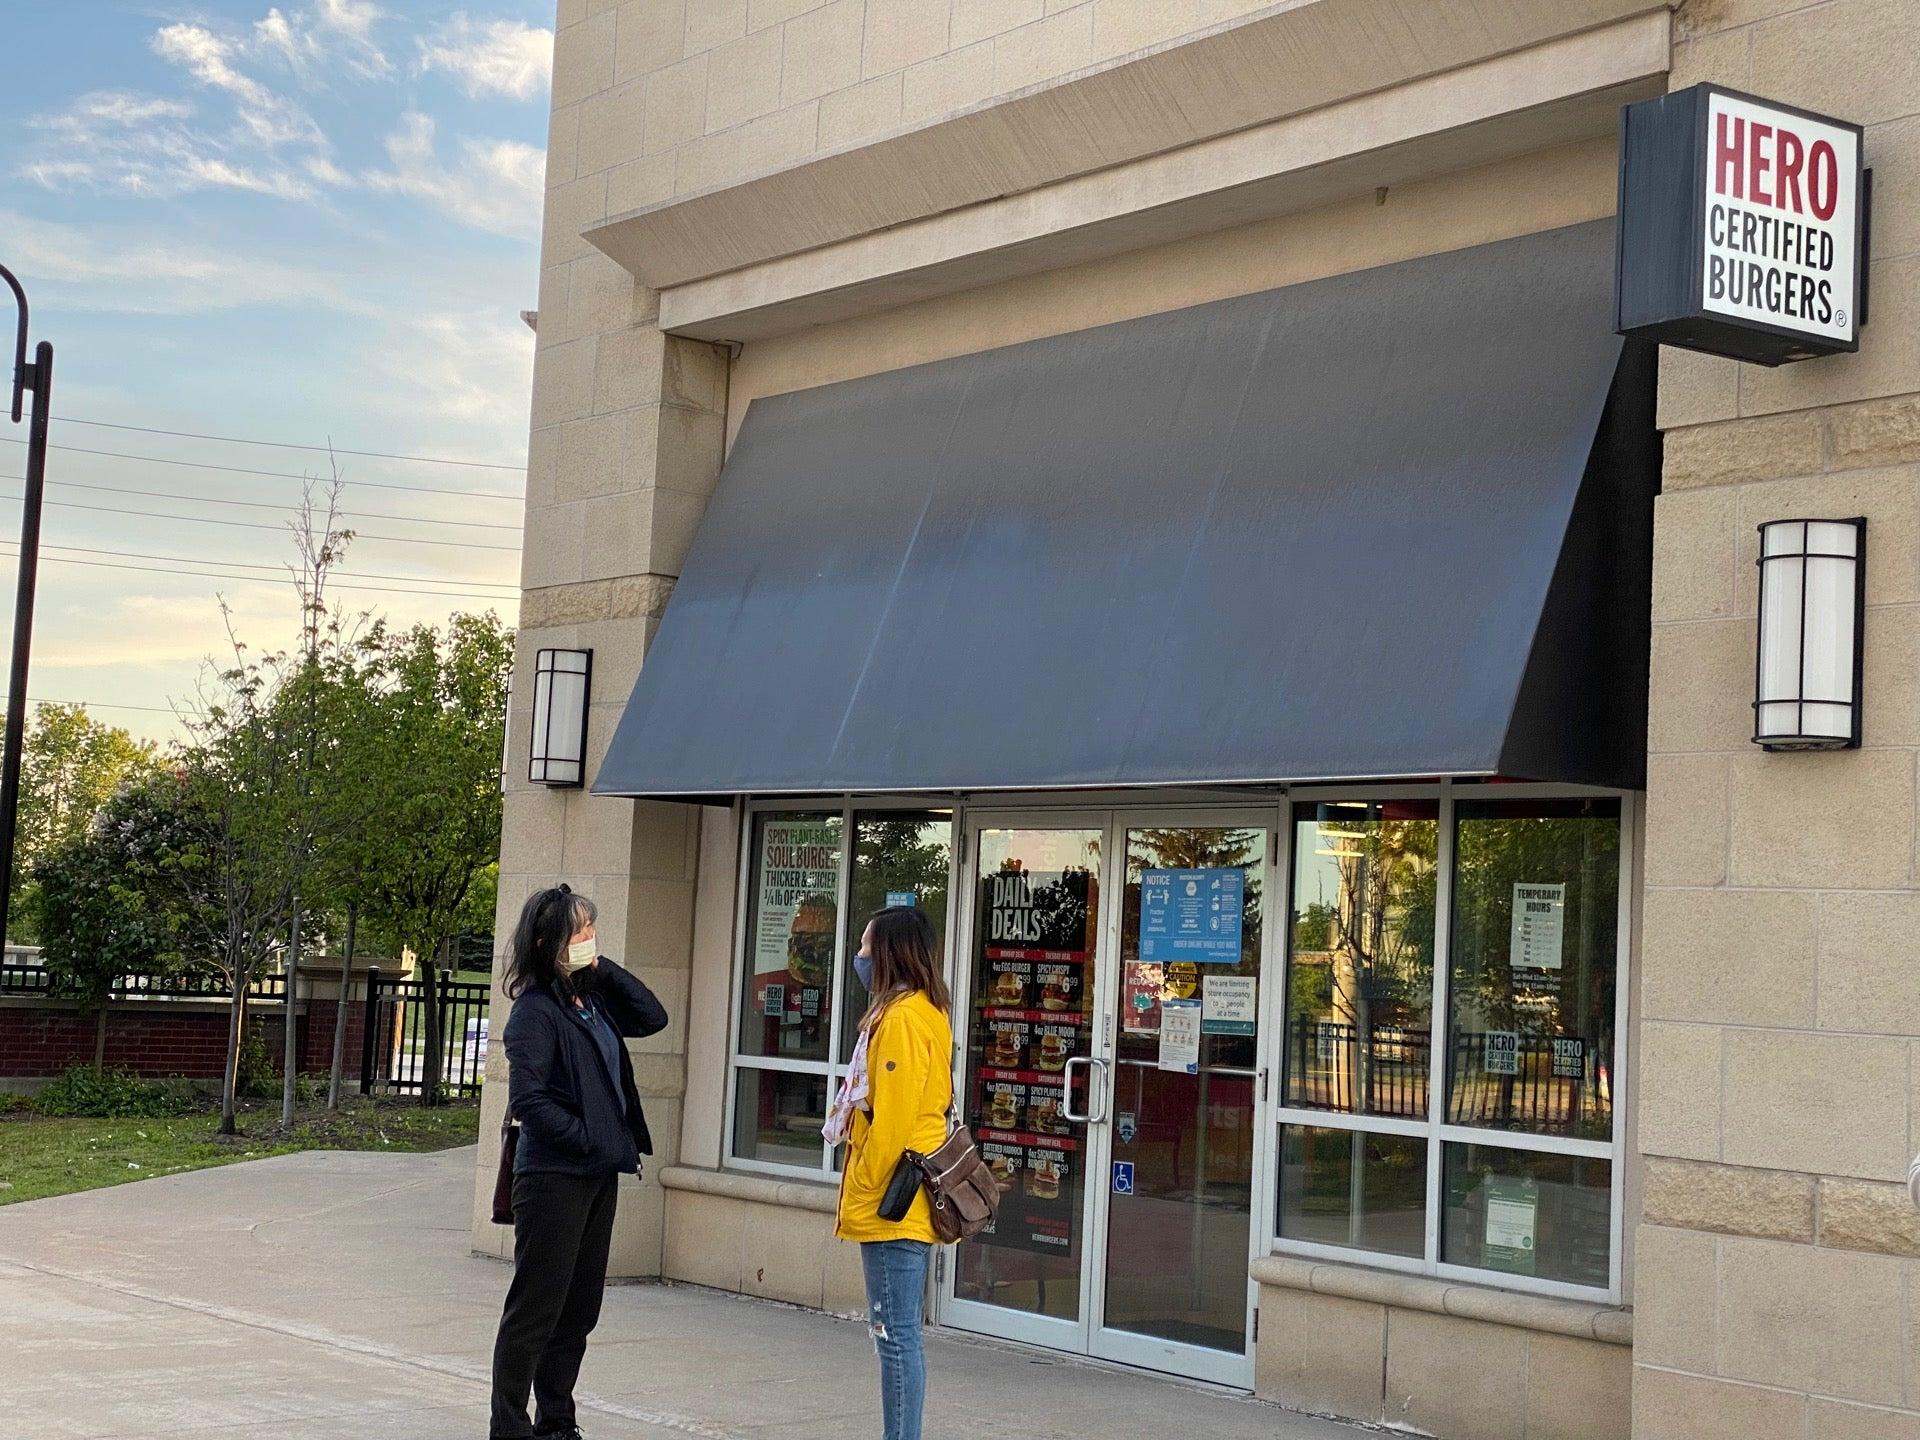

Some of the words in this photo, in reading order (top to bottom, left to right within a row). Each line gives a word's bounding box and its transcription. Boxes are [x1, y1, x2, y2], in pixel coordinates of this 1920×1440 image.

[1715, 112, 1838, 221] HERO
[1710, 203, 1833, 271] CERTIFIED
[1709, 254, 1832, 324] BURGERS
[768, 829, 789, 844] SPICY
[766, 846, 795, 868] SOUL
[797, 847, 837, 869] BURGER
[766, 871, 800, 887] THICKER
[801, 871, 807, 887] &
[1146, 875, 1170, 886] NOTICE
[993, 876, 1037, 907] DAILY
[1517, 889, 1561, 900] TEMPORARY
[784, 890, 795, 906] OF
[1526, 902, 1551, 913] HOURS
[992, 909, 1041, 941] DEALS
[1002, 963, 1011, 972] EGG
[1012, 963, 1031, 973] BURGER
[1037, 963, 1052, 973] SPICY
[1052, 964, 1070, 975] CRISPY
[1169, 973, 1196, 981] CAUTION
[1209, 979, 1218, 987] We
[767, 986, 782, 999] HERO
[803, 989, 819, 1001] HERO
[998, 1022, 1012, 1032] HEAVY
[1013, 1023, 1029, 1033] HITTER
[1488, 1034, 1515, 1051] HERO
[1554, 1039, 1582, 1057] HERO
[1488, 1051, 1514, 1061] CERTIFIED
[1554, 1056, 1581, 1066] CERTIFIED
[1487, 1061, 1514, 1071] BURGERS
[1553, 1066, 1581, 1077] BURGERS
[1057, 1076, 1065, 1084] DEA
[1012, 1084, 1025, 1095] HERO
[1031, 1086, 1044, 1095] SPICY
[1044, 1087, 1065, 1097] PLANT-BA
